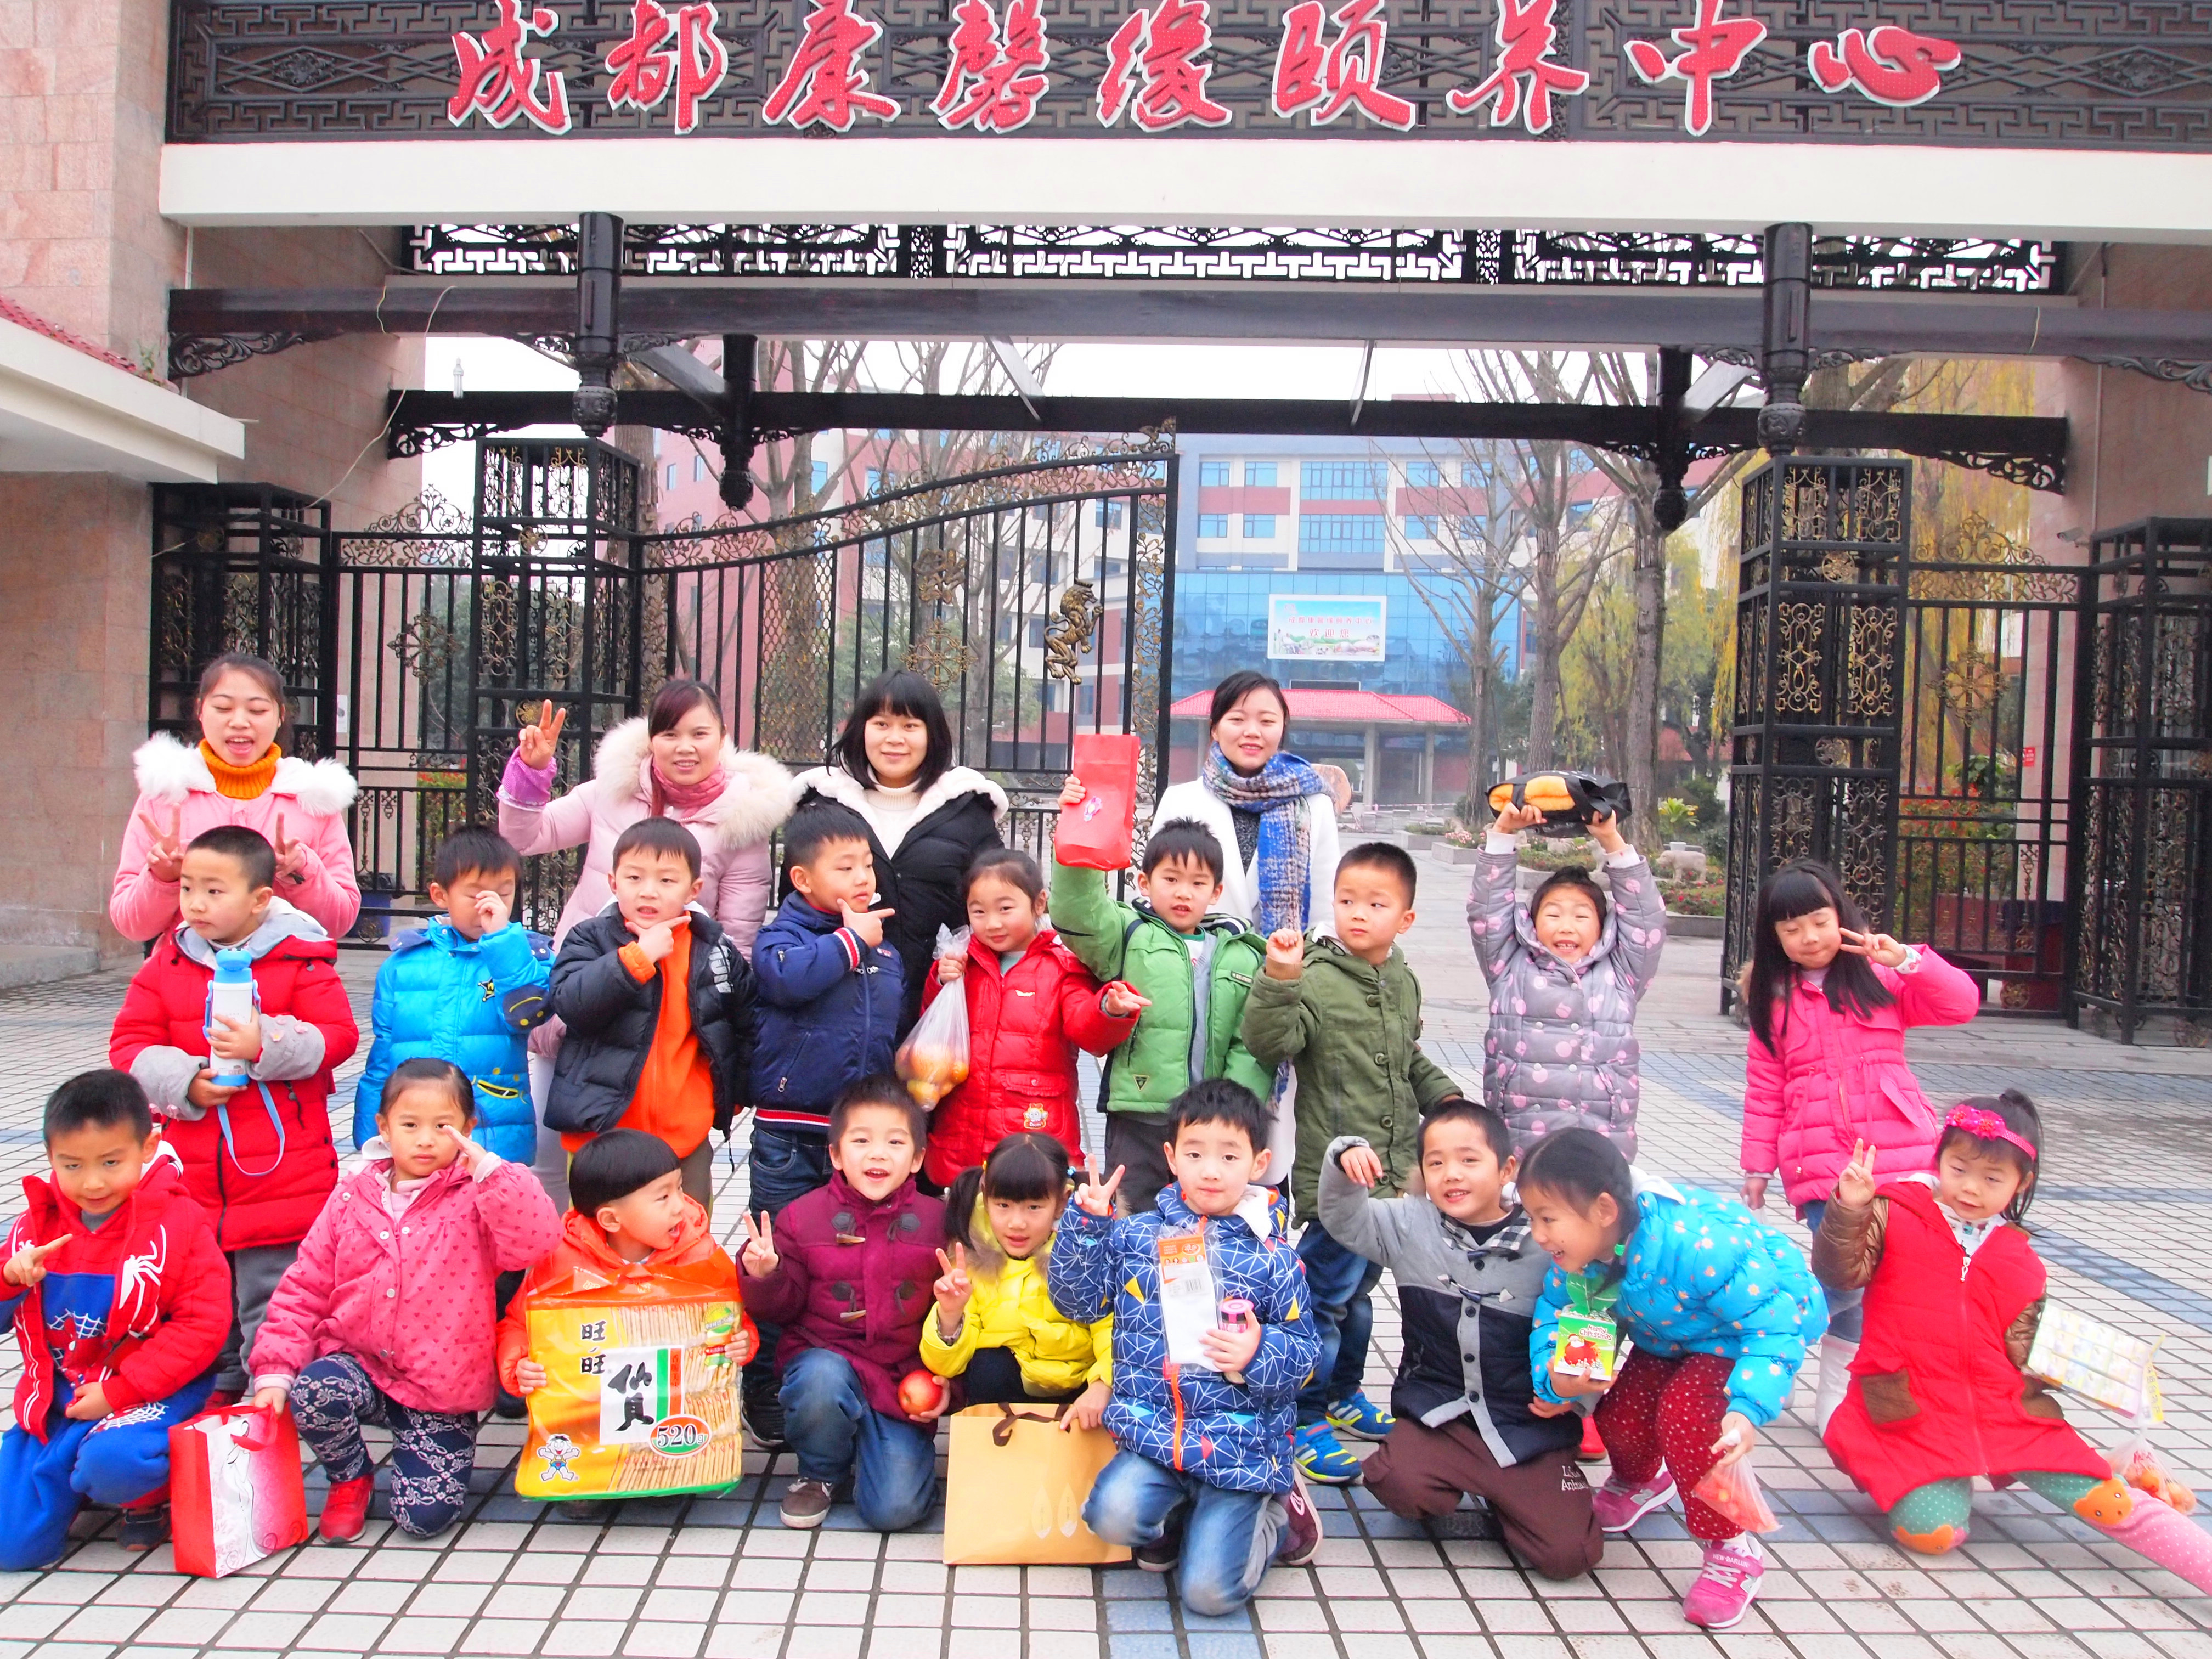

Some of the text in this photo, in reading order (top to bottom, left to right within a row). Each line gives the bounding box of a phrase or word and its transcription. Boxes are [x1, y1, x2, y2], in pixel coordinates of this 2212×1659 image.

[1310, 629, 1350, 638] 欢迎您
[581, 1319, 607, 1375] 旺旺
[657, 1424, 705, 1448] 520g
